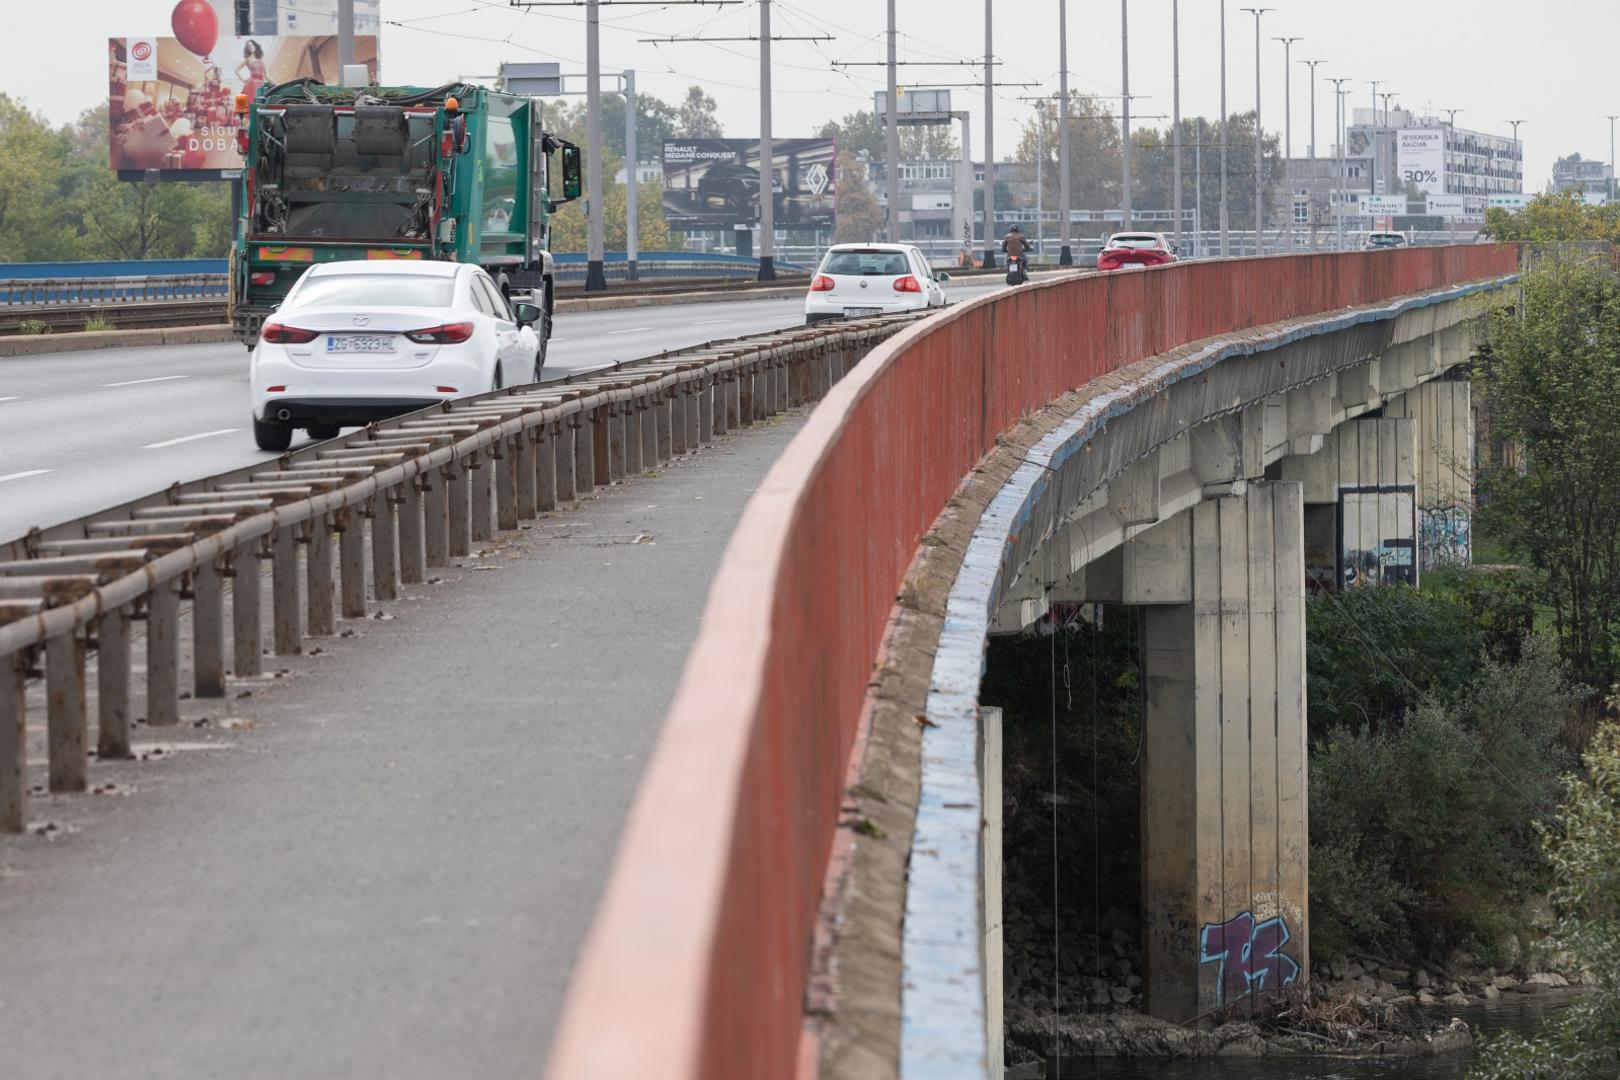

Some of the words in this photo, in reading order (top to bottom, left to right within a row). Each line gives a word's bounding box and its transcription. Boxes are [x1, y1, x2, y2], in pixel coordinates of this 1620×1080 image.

[201, 126, 236, 136] SIGU
[189, 138, 239, 151] DOBA
[696, 151, 737, 159] CONQUEST
[1404, 170, 1438, 183] 30%
